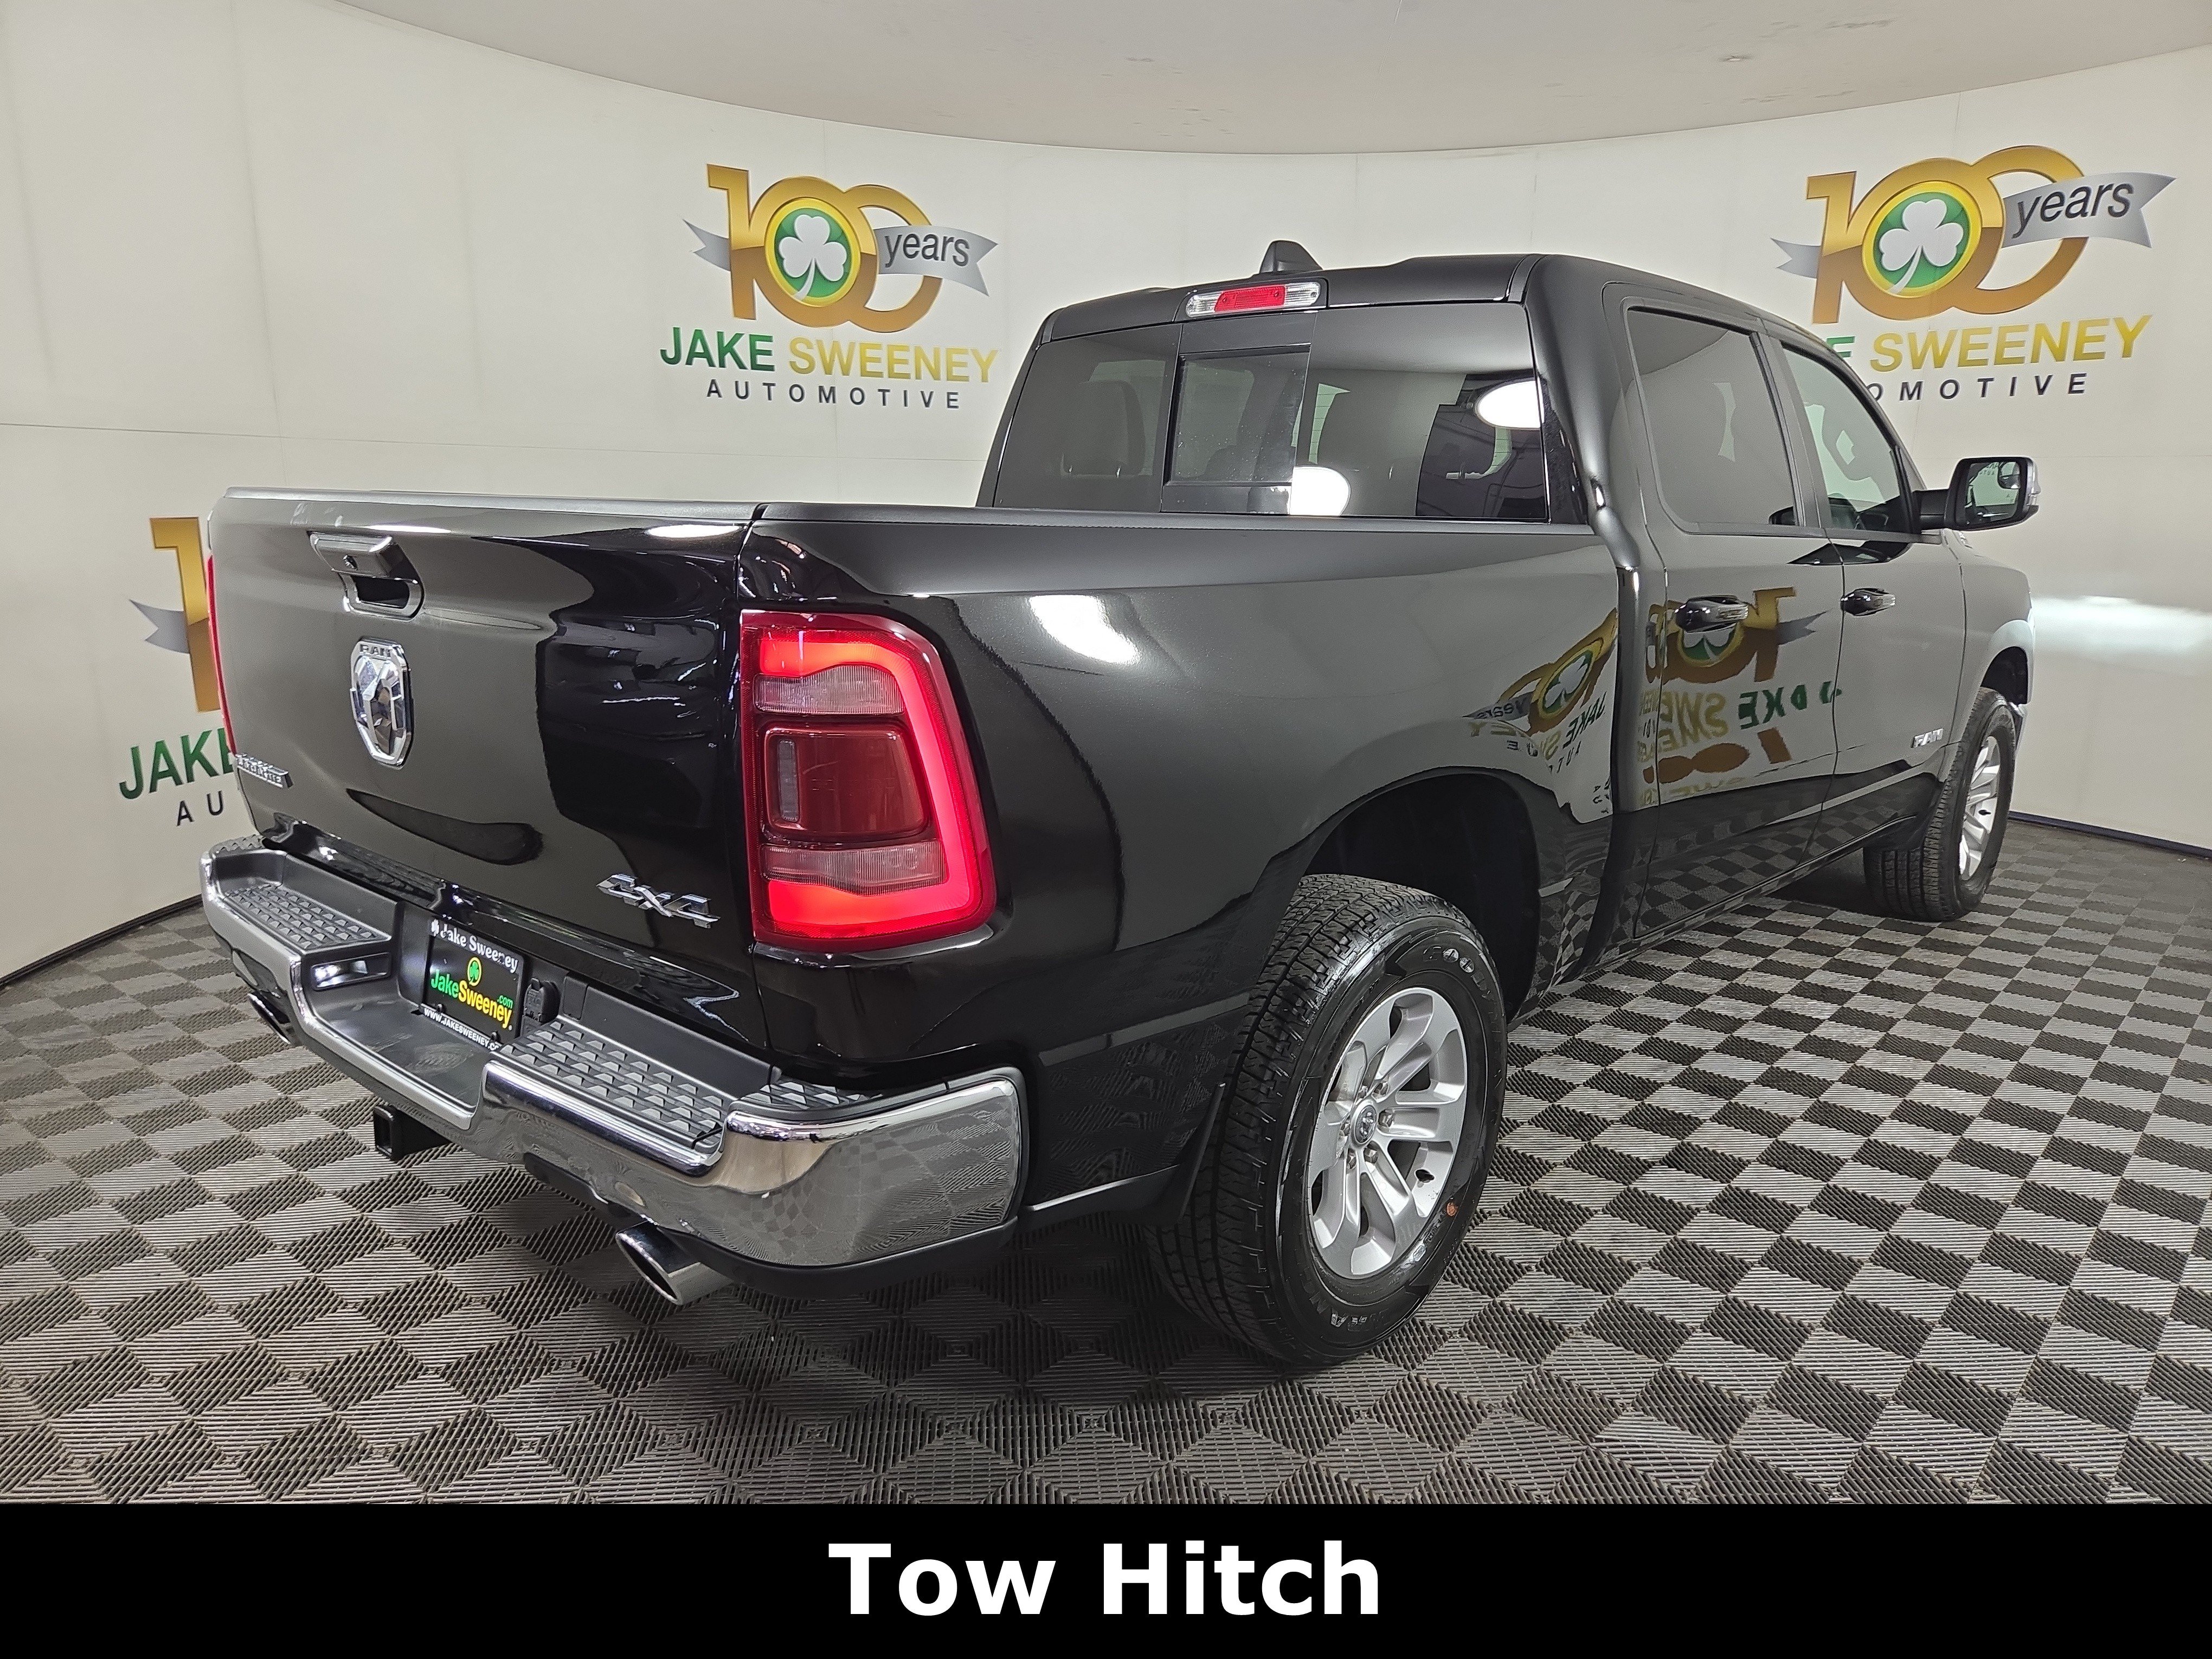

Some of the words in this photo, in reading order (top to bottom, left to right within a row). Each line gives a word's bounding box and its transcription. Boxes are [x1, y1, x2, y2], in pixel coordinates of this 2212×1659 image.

[1806, 145, 2089, 324] 100
[2012, 182, 2134, 239] years
[706, 164, 943, 333] 100
[884, 233, 970, 268] years
[660, 326, 775, 372] JAKE
[789, 337, 999, 383] SWEENEY
[1870, 315, 2152, 372] SWEENEY
[707, 379, 960, 409] AUTOMOTIVE
[1867, 372, 2088, 401] OMOTIVE
[440, 923, 467, 948] Jake
[469, 935, 518, 974] Sweeney
[497, 995, 513, 1009] .com
[424, 1008, 500, 1051] WWW.JAKESWEENEY.CO
